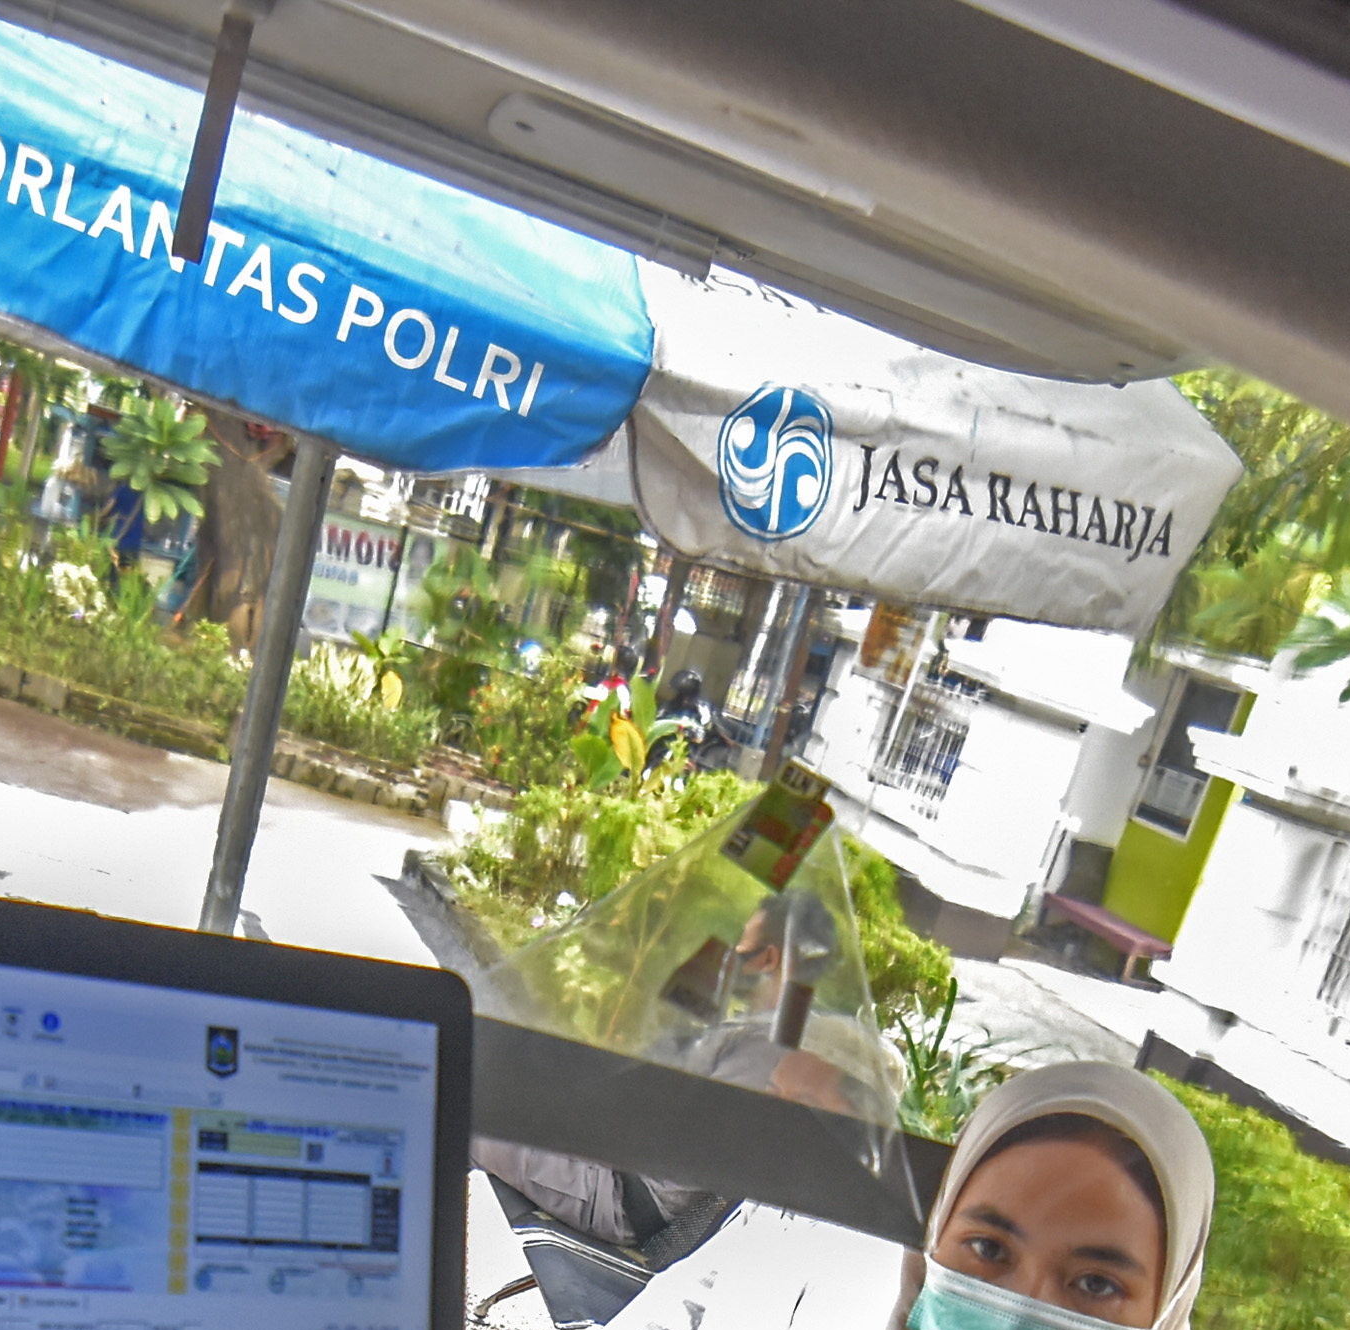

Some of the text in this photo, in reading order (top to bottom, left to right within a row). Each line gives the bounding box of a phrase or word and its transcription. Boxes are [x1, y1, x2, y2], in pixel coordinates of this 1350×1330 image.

[337, 284, 544, 418] POLRI
[853, 443, 1174, 562] JASA RAHARJA
